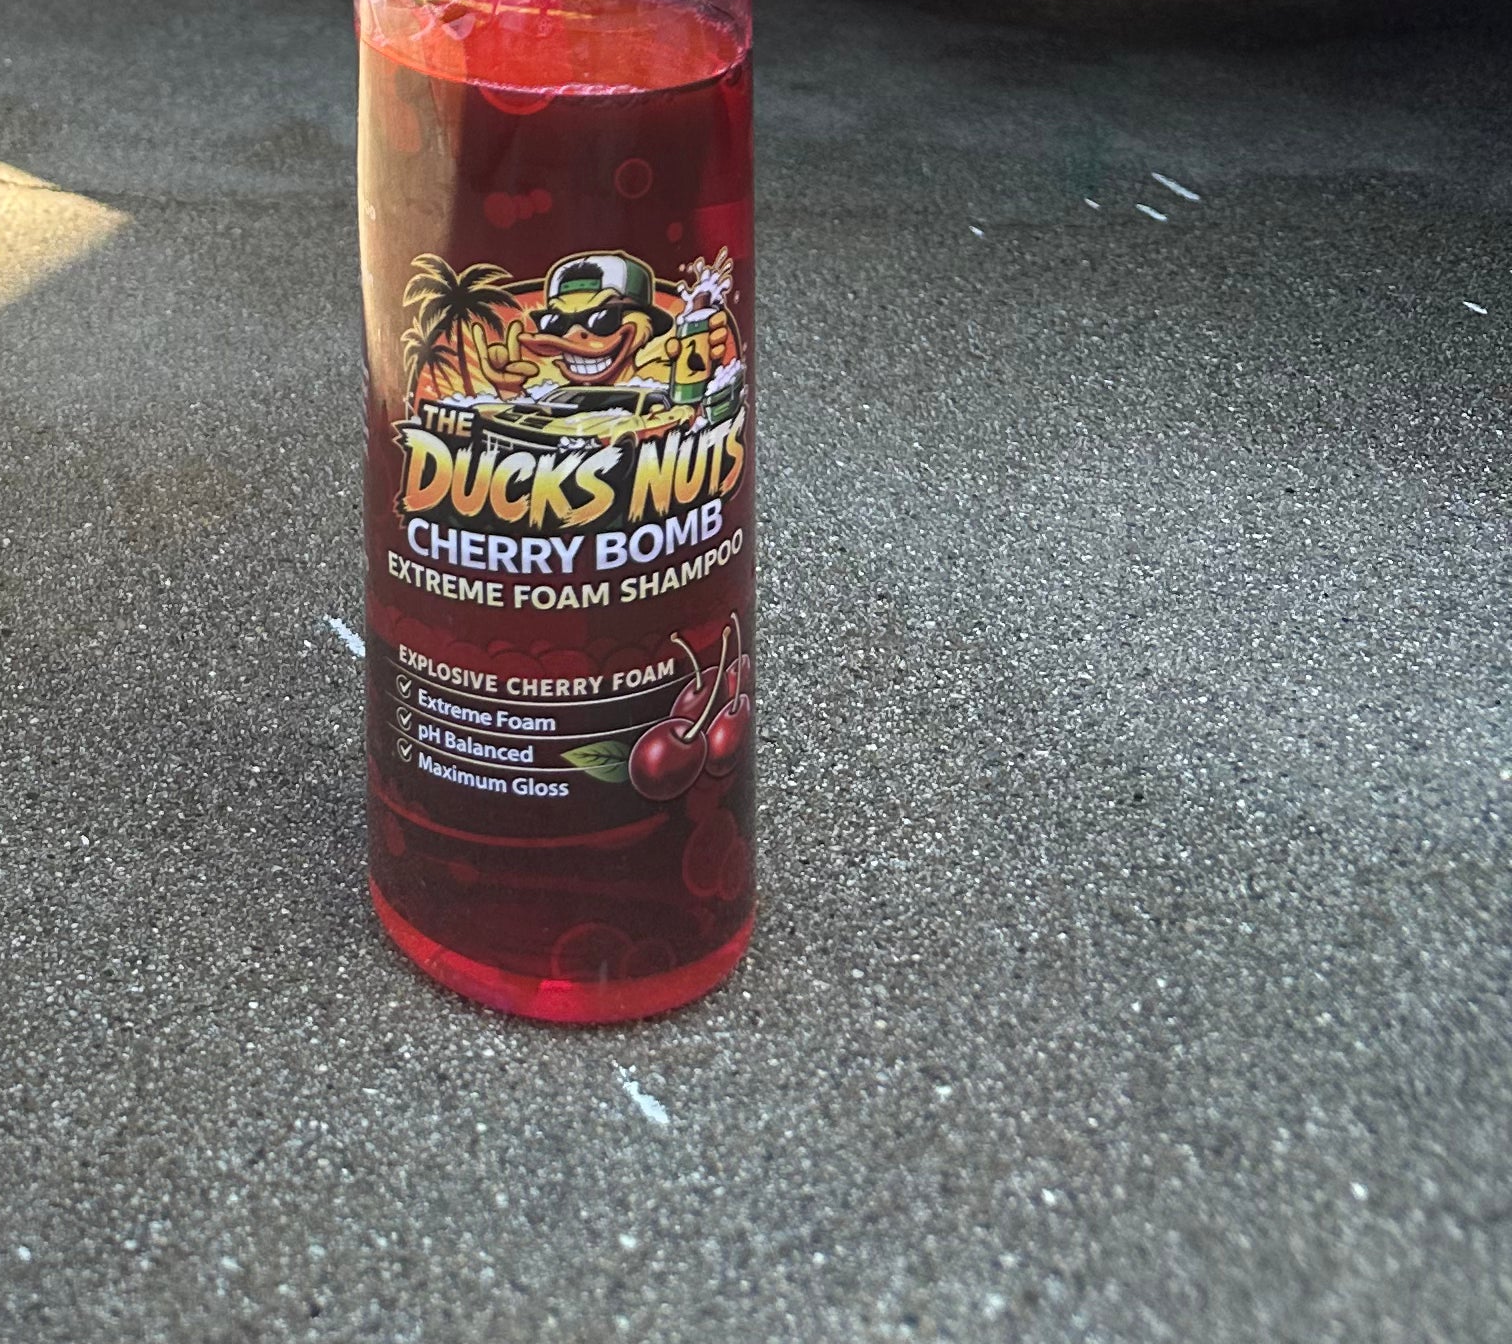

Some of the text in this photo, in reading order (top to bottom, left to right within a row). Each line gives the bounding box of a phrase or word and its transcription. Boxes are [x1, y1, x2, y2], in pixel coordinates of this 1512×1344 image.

[421, 403, 477, 438] THE
[402, 410, 745, 530] DUCKS NUTS
[407, 500, 723, 575] CHERRY BOMB
[387, 528, 744, 610] EXTREME FOAM SHAMPOO
[398, 643, 676, 697] EXPLOSIVE CHERRY FOAM
[417, 688, 557, 733] Extreme Foam
[417, 723, 535, 764] pH Balanced
[417, 752, 570, 798] Maximum Gloss
